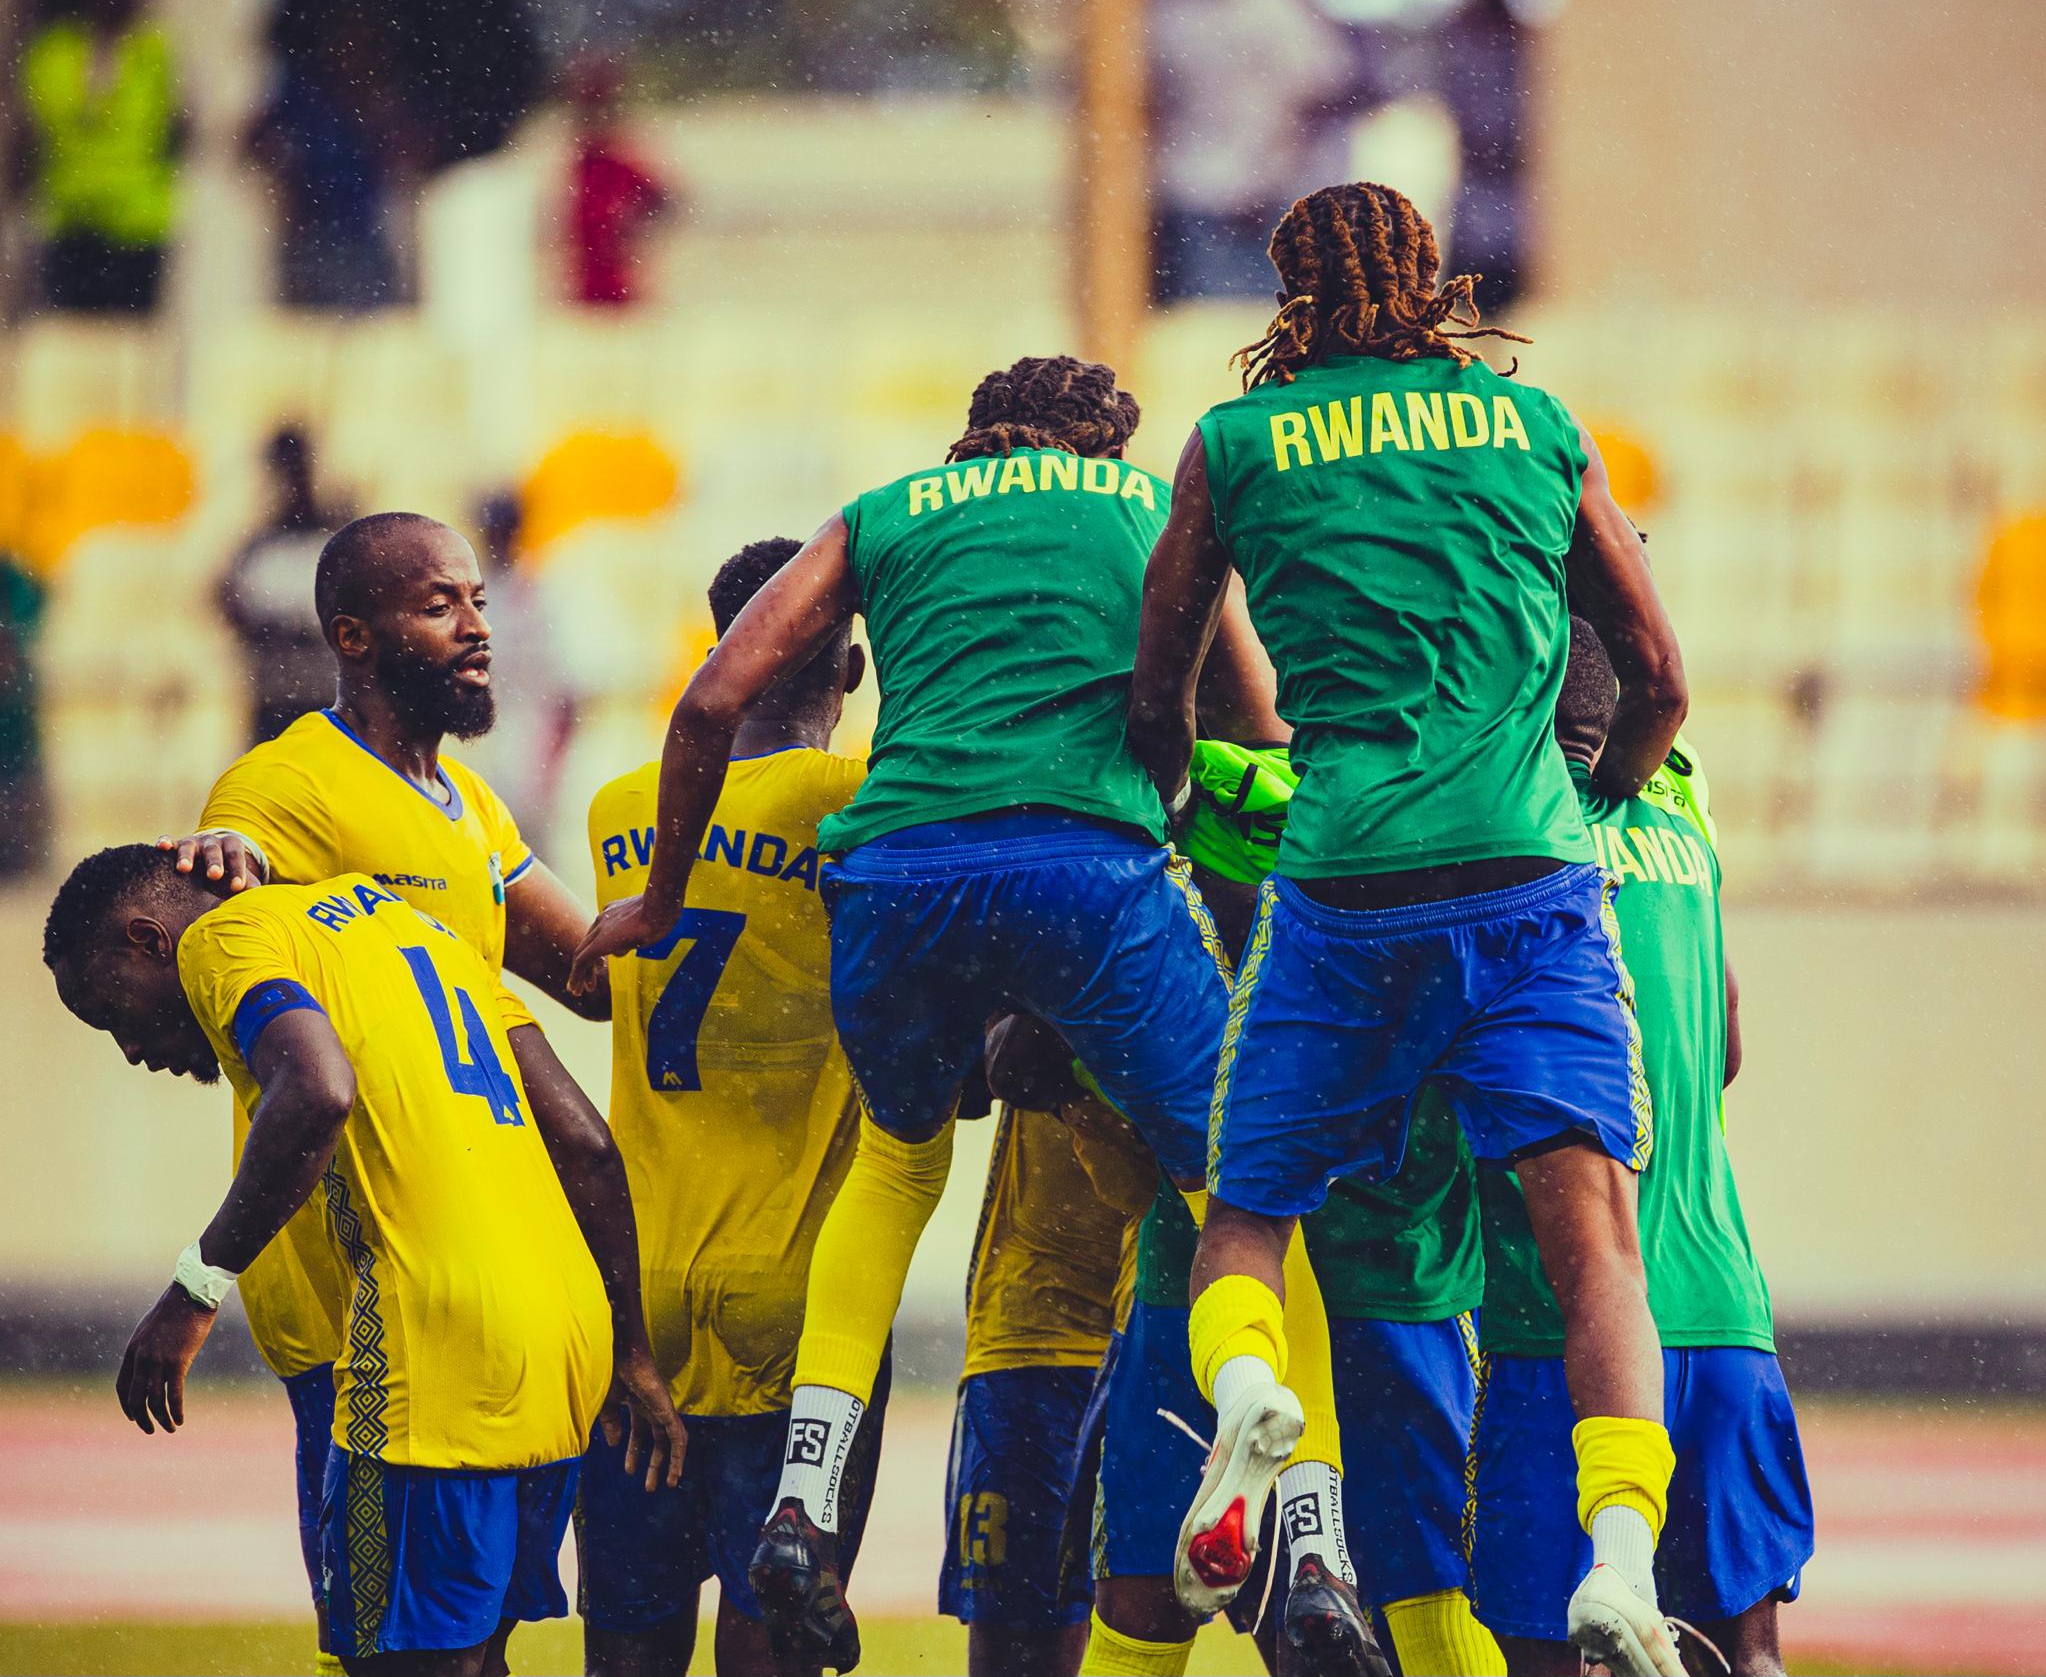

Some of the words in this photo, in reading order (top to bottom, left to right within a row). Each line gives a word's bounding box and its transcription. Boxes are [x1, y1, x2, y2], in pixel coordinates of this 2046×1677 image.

[1269, 392, 1531, 472] RWANDA
[909, 453, 1155, 516] RWANDA
[602, 824, 819, 892] RWNDA
[1592, 823, 1713, 897] ANDA
[397, 946, 526, 1127] 4
[636, 907, 747, 1092] 7
[788, 1422, 826, 1462] FS
[821, 1399, 861, 1524] OTBALLSOCKS
[960, 1492, 1008, 1567] 13
[1284, 1497, 1318, 1540] FS
